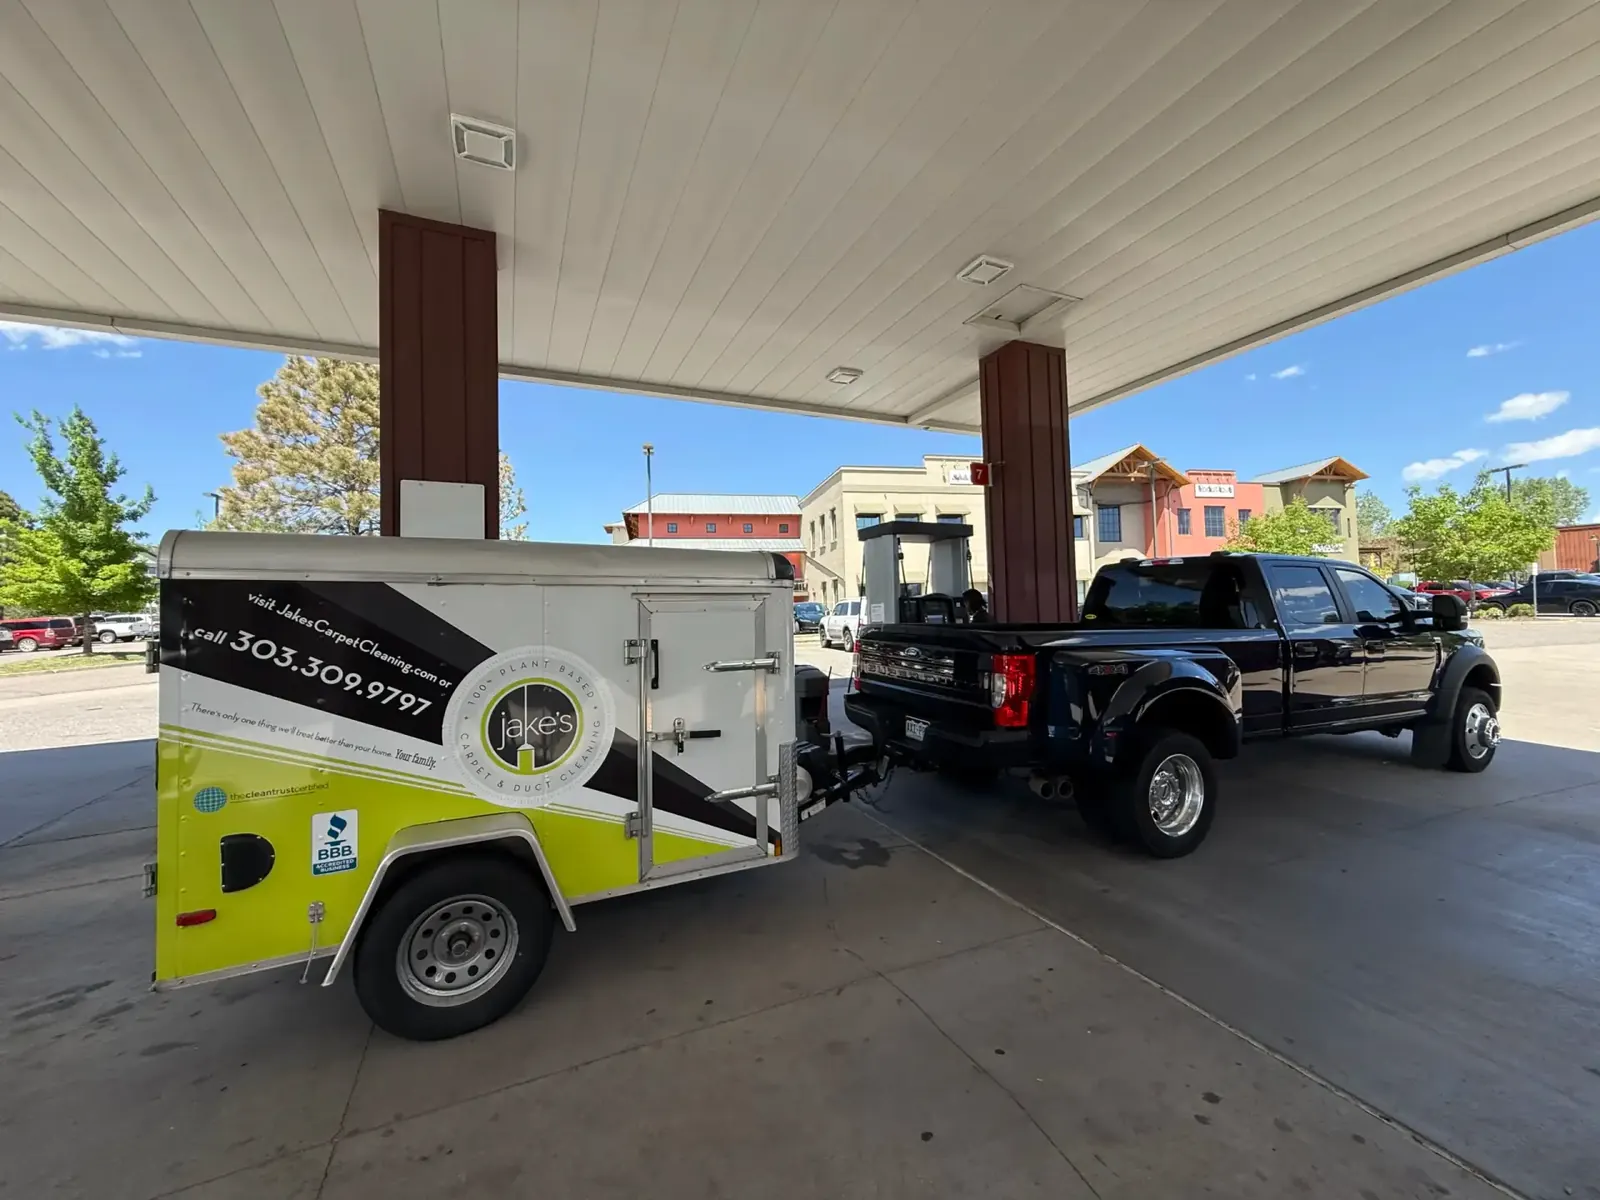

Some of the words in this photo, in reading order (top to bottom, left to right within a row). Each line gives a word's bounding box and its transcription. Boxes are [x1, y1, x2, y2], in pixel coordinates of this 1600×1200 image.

[976, 468, 983, 480] 7
[248, 593, 276, 611] visit
[276, 604, 438, 683] JakesCarpetCleaning.com
[438, 679, 452, 688] or
[194, 626, 228, 645] call
[229, 629, 433, 717] 303.309.9797
[500, 660, 550, 676] PLANT
[559, 664, 595, 699] BASED
[191, 702, 221, 717] There's
[222, 712, 240, 723] only
[240, 718, 256, 726] one
[258, 719, 278, 732] thing
[278, 726, 297, 735] we'll
[296, 729, 314, 739] treat
[314, 732, 337, 744] better
[338, 738, 354, 748] than
[354, 744, 371, 752] your
[395, 748, 412, 763] Your
[411, 753, 437, 770] family.
[497, 699, 573, 751] jake's
[460, 732, 492, 780] CARPET
[497, 780, 505, 788] &
[514, 781, 551, 792] DUCT
[559, 719, 600, 782] CLEANING
[316, 858, 355, 869] ACCREDITED
[318, 845, 352, 861] BBB
